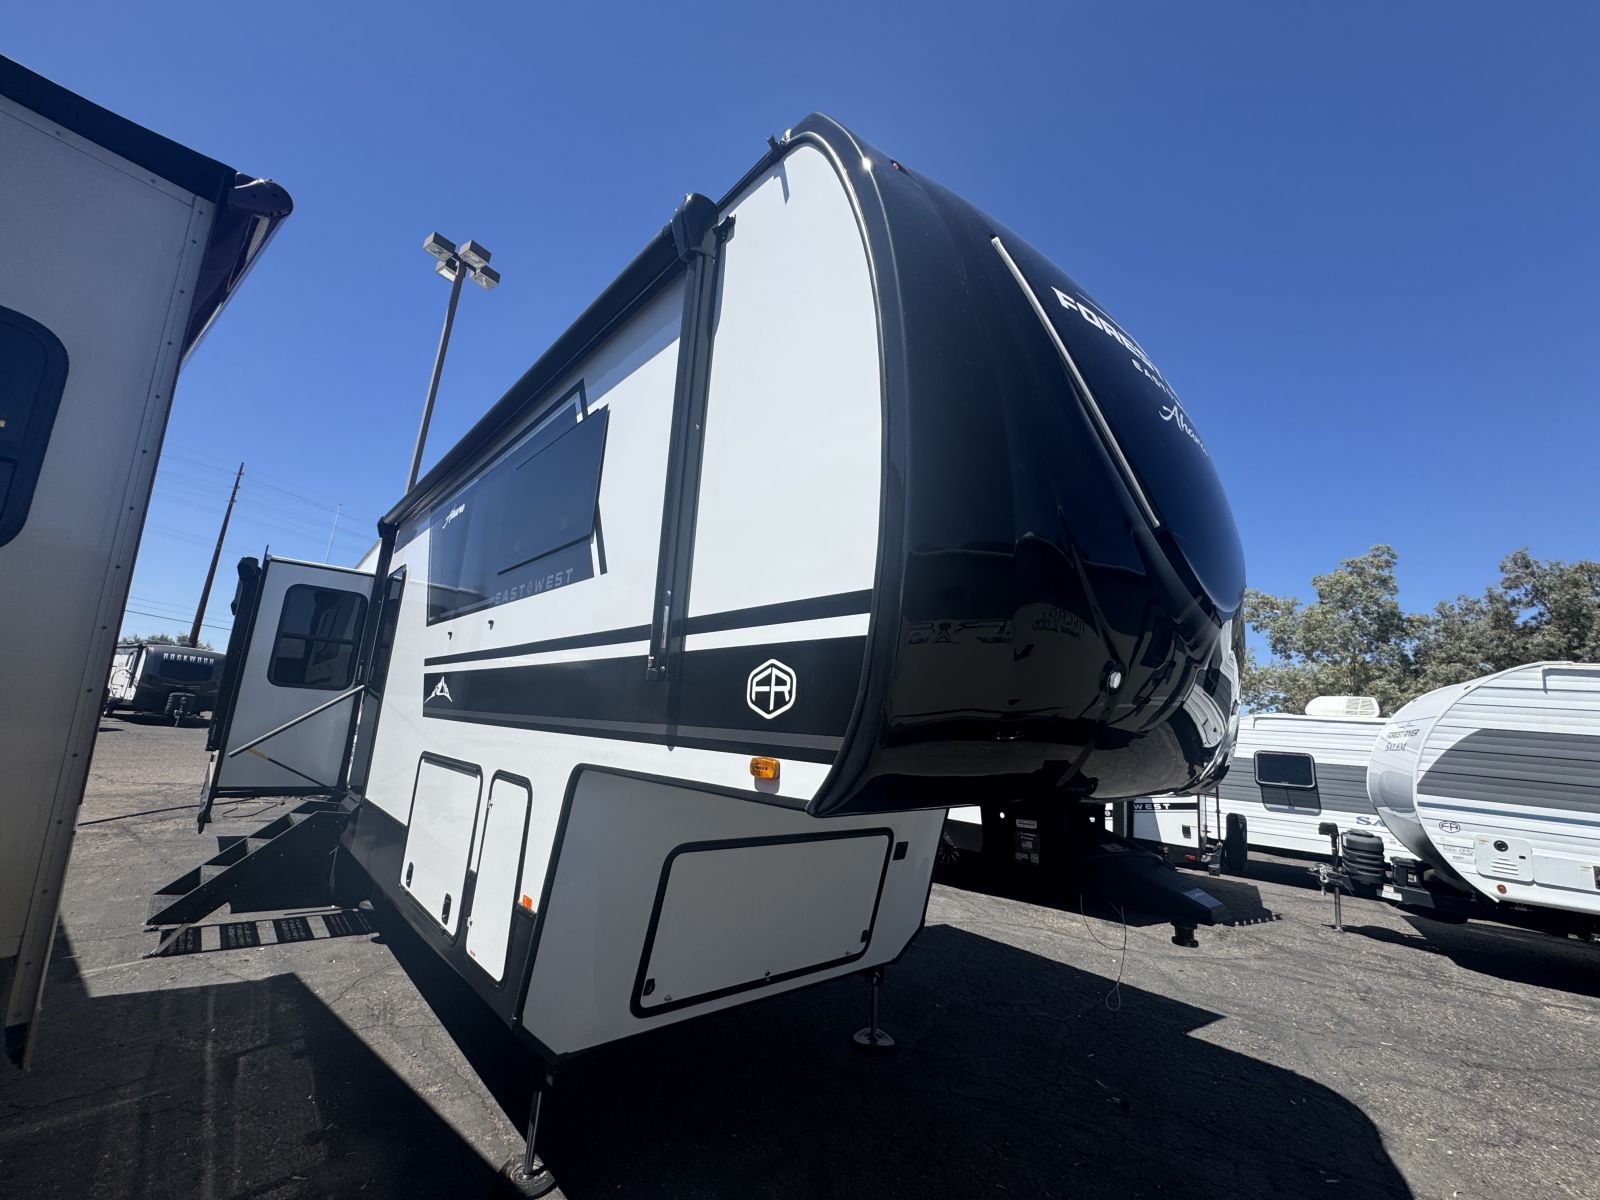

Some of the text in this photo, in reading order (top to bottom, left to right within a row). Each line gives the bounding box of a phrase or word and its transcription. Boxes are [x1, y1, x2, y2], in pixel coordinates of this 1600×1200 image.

[494, 567, 574, 606] EAST WEST
[163, 652, 215, 665] ROCKWOOD
[1384, 742, 1408, 752] SALEM
